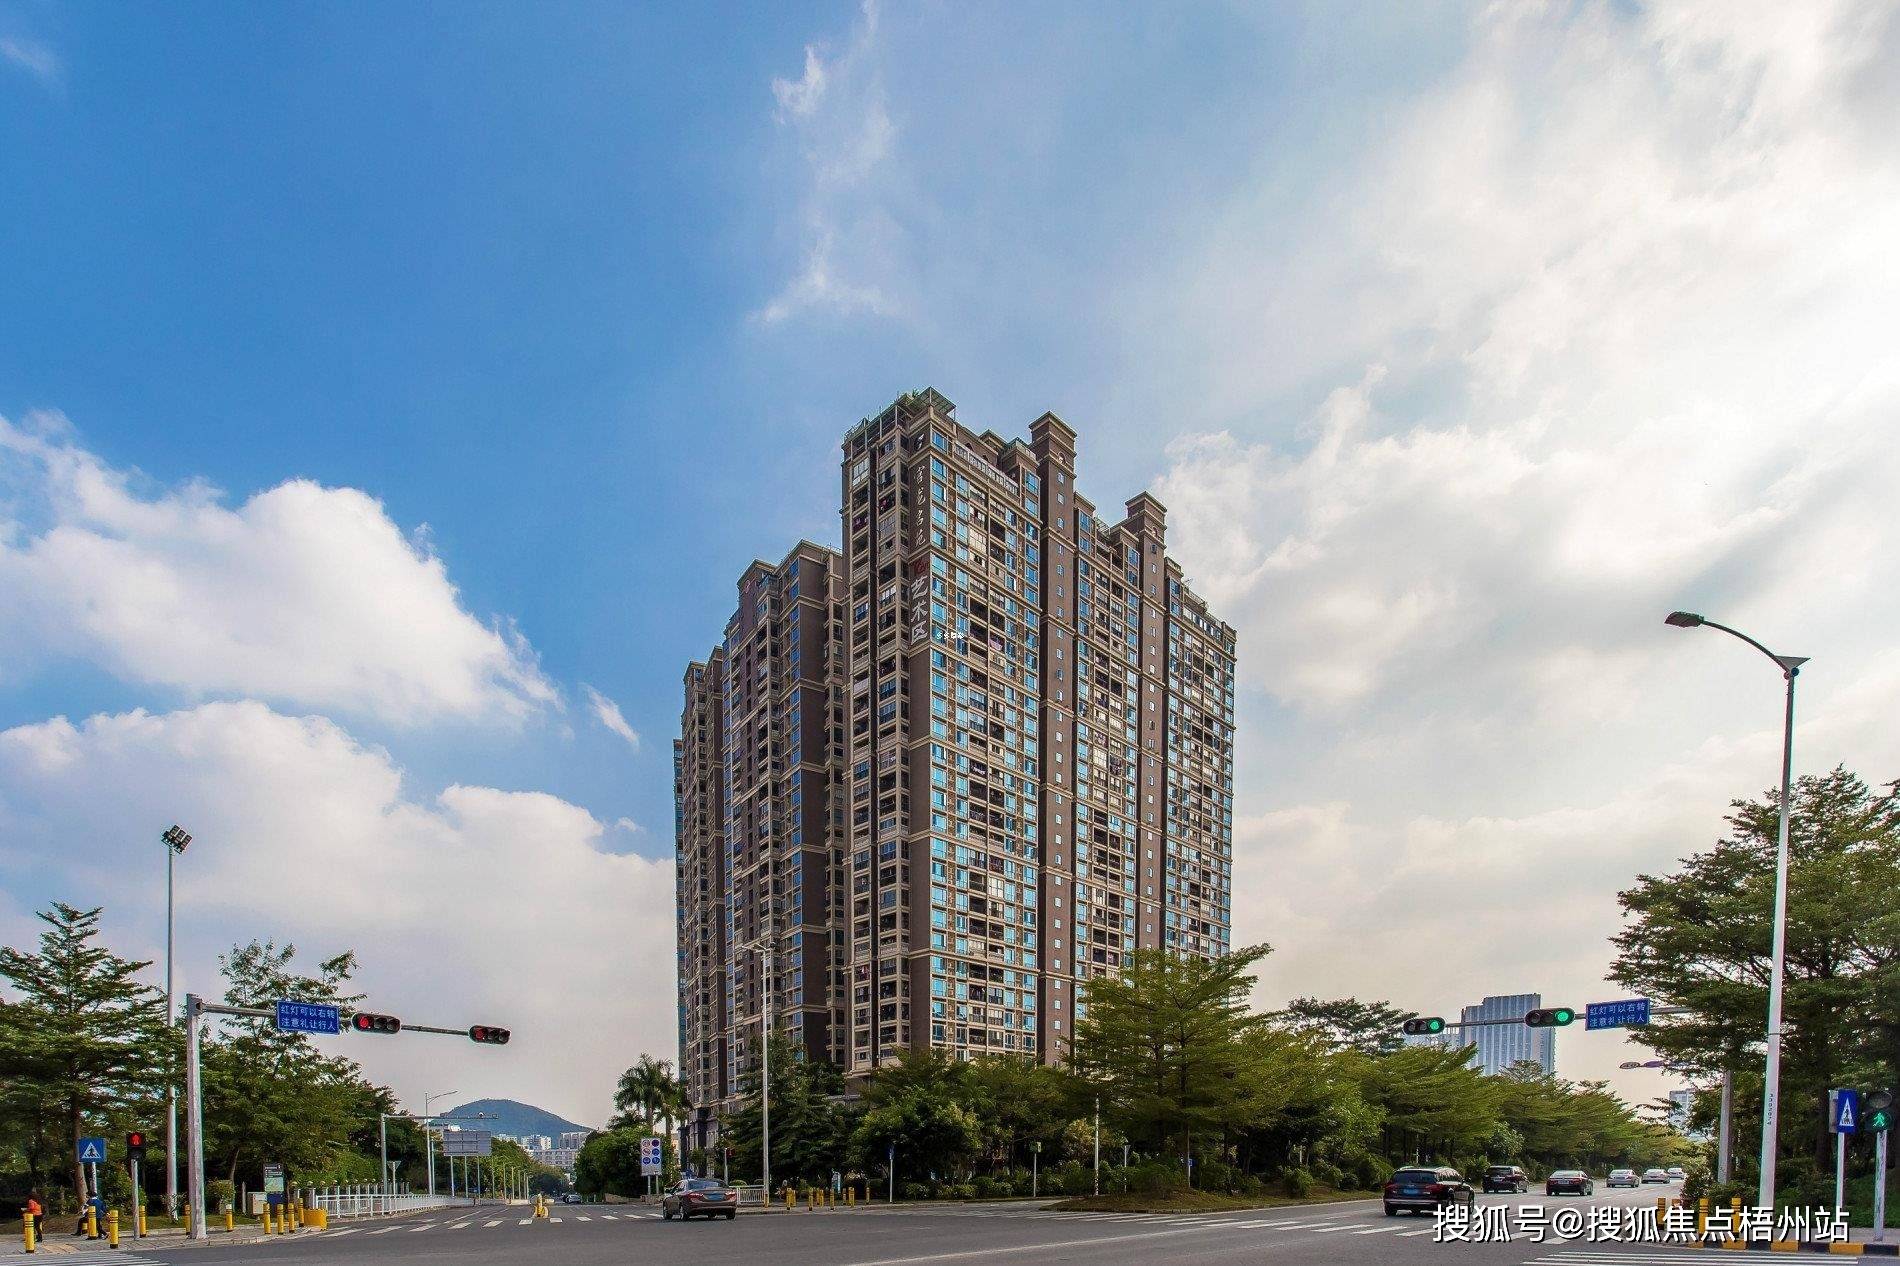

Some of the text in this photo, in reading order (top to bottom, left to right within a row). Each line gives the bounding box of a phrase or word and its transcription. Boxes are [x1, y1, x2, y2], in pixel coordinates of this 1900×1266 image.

[280, 1005, 336, 1019] 红灯可以右转
[1590, 1002, 1646, 1016] 红灯可以右转
[281, 1017, 336, 1030] 注意礼让行人
[1590, 1014, 1644, 1027] 注意礼让行人
